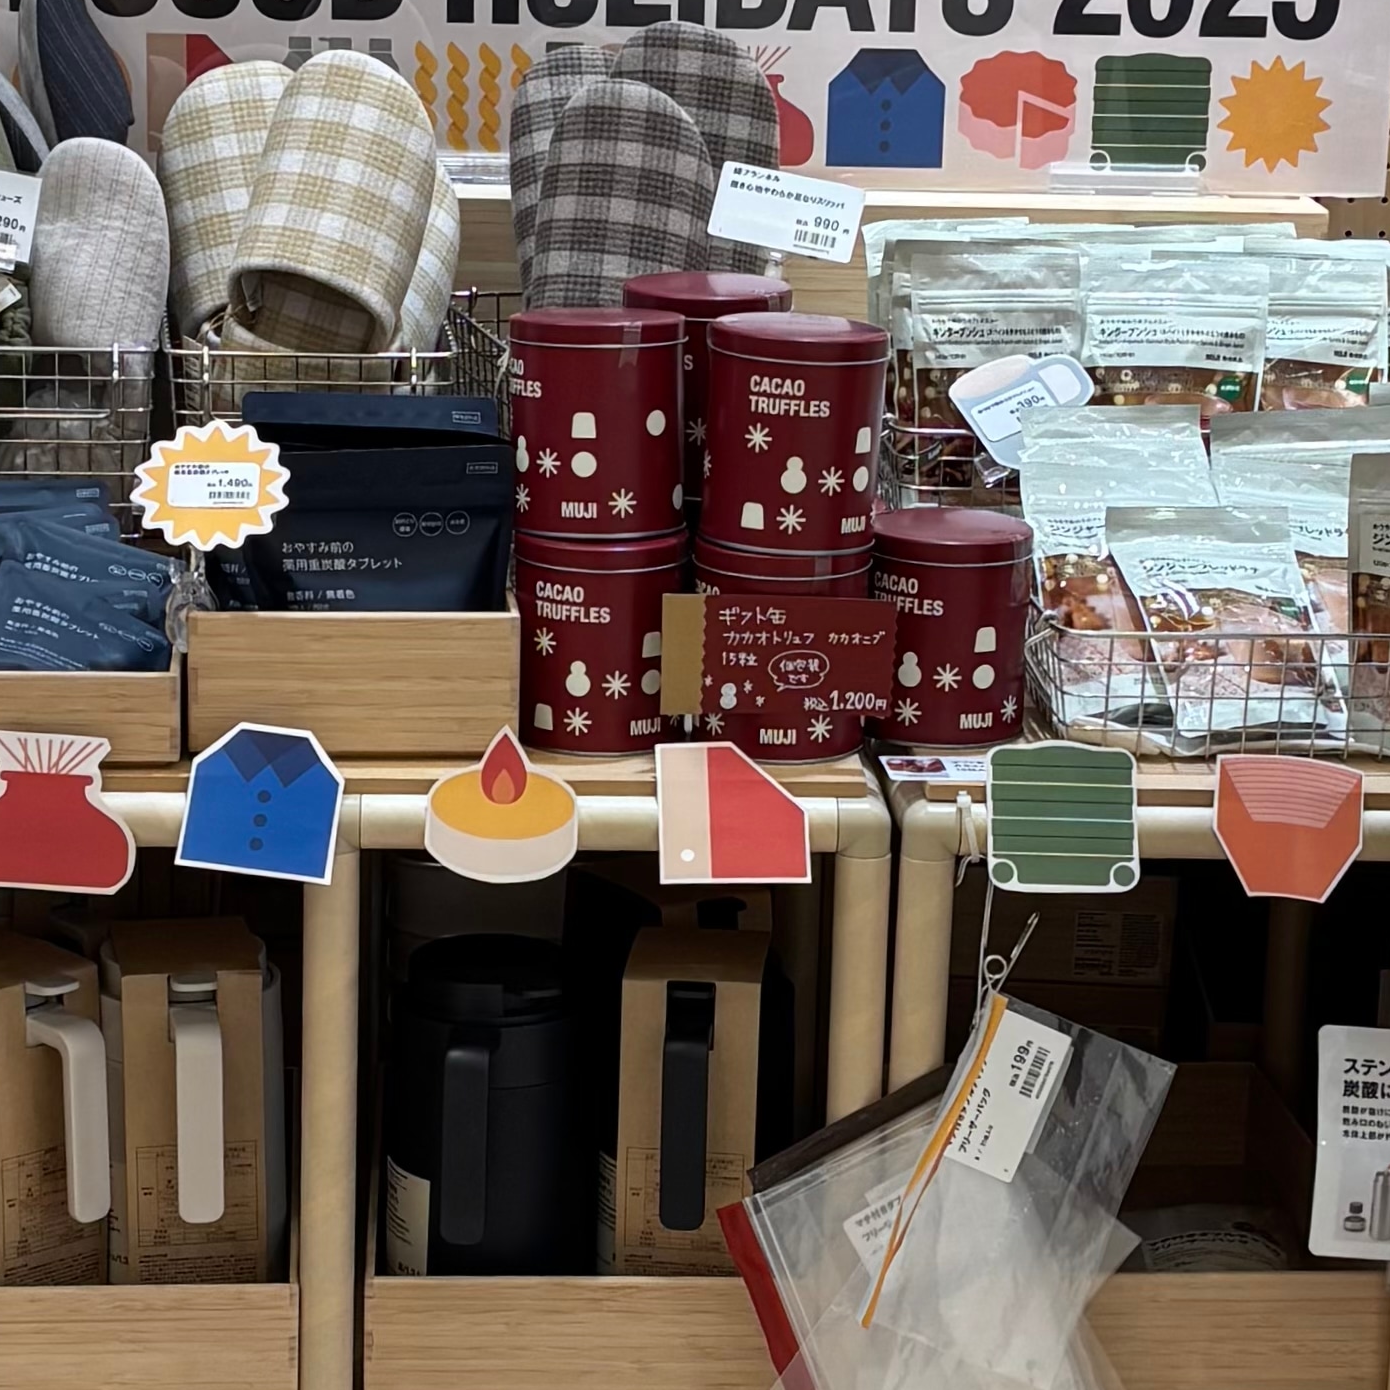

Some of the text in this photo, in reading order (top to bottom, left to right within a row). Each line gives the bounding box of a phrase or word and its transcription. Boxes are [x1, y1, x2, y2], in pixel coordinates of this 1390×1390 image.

[749, 374, 806, 397] CACAO
[748, 395, 831, 419] TRUFFLES
[560, 501, 598, 520] MUJI
[840, 516, 867, 535] MUJI
[281, 540, 354, 555] おやすみ前の
[281, 556, 403, 572] 薬用重炭酸タブレット
[535, 580, 586, 604] CACAO
[874, 571, 919, 595] CACAO
[535, 600, 611, 624] TRUFFLES
[717, 605, 787, 626] ギフト缶
[722, 629, 886, 647] カカオトリュフ カカオニブ
[722, 651, 759, 668] 15粒
[778, 657, 820, 673] 個包装
[787, 672, 810, 684] です
[629, 717, 662, 736] MUJI
[958, 711, 994, 730] MUJI
[758, 727, 797, 746] MUJI
[958, 1088, 992, 1153] フリーザーバッグ
